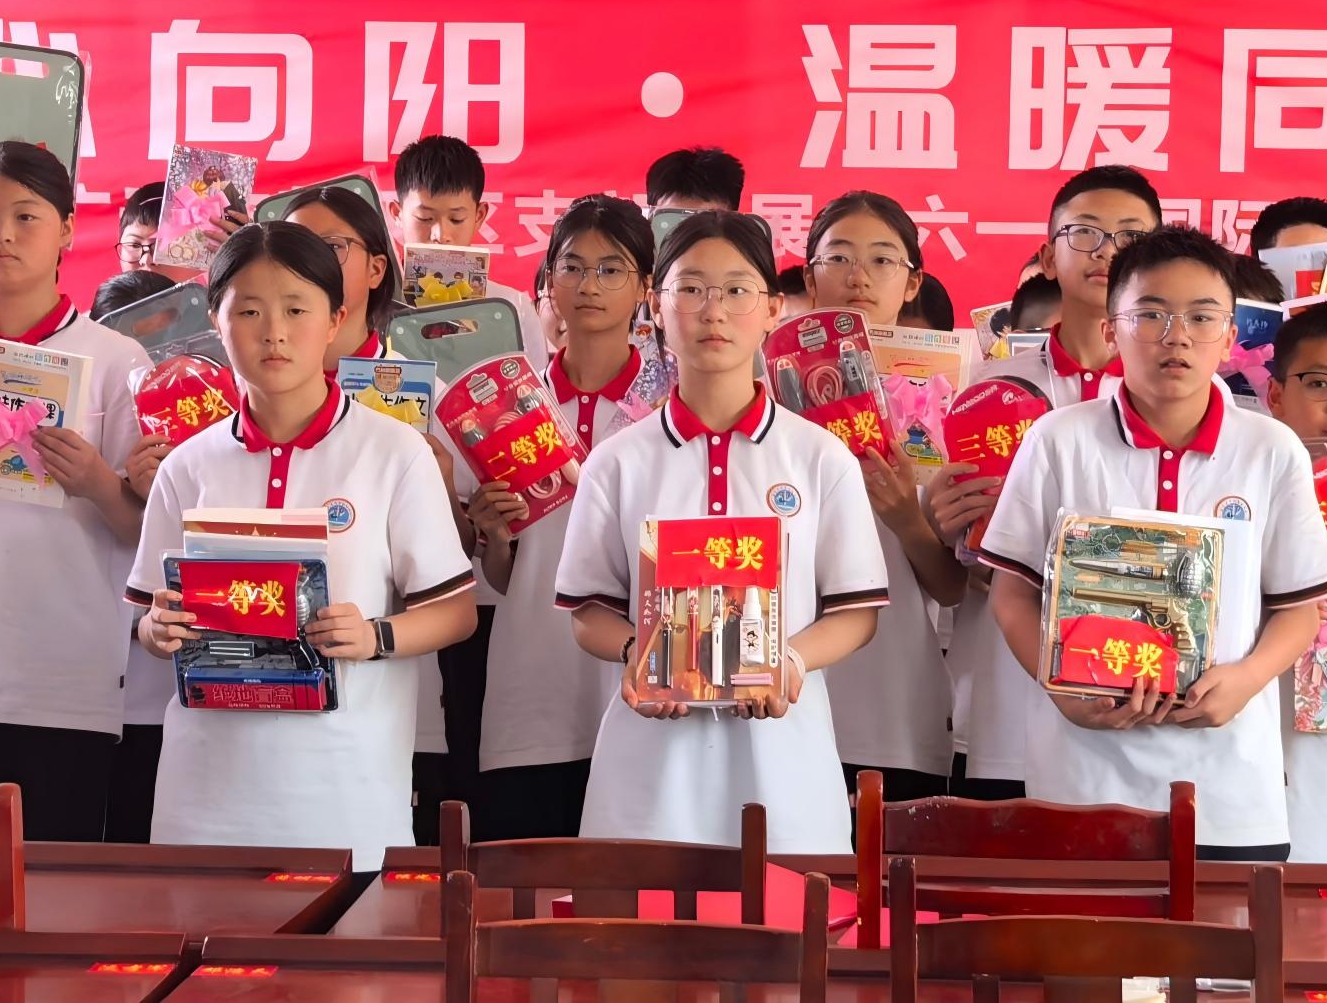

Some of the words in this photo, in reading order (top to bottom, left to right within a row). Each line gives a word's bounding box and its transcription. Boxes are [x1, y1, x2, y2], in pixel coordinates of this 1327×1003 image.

[488, 421, 563, 481] 二等奖
[672, 536, 764, 571] 一等奖
[195, 580, 287, 617] 一等奖
[1069, 638, 1163, 678] 一等奖
